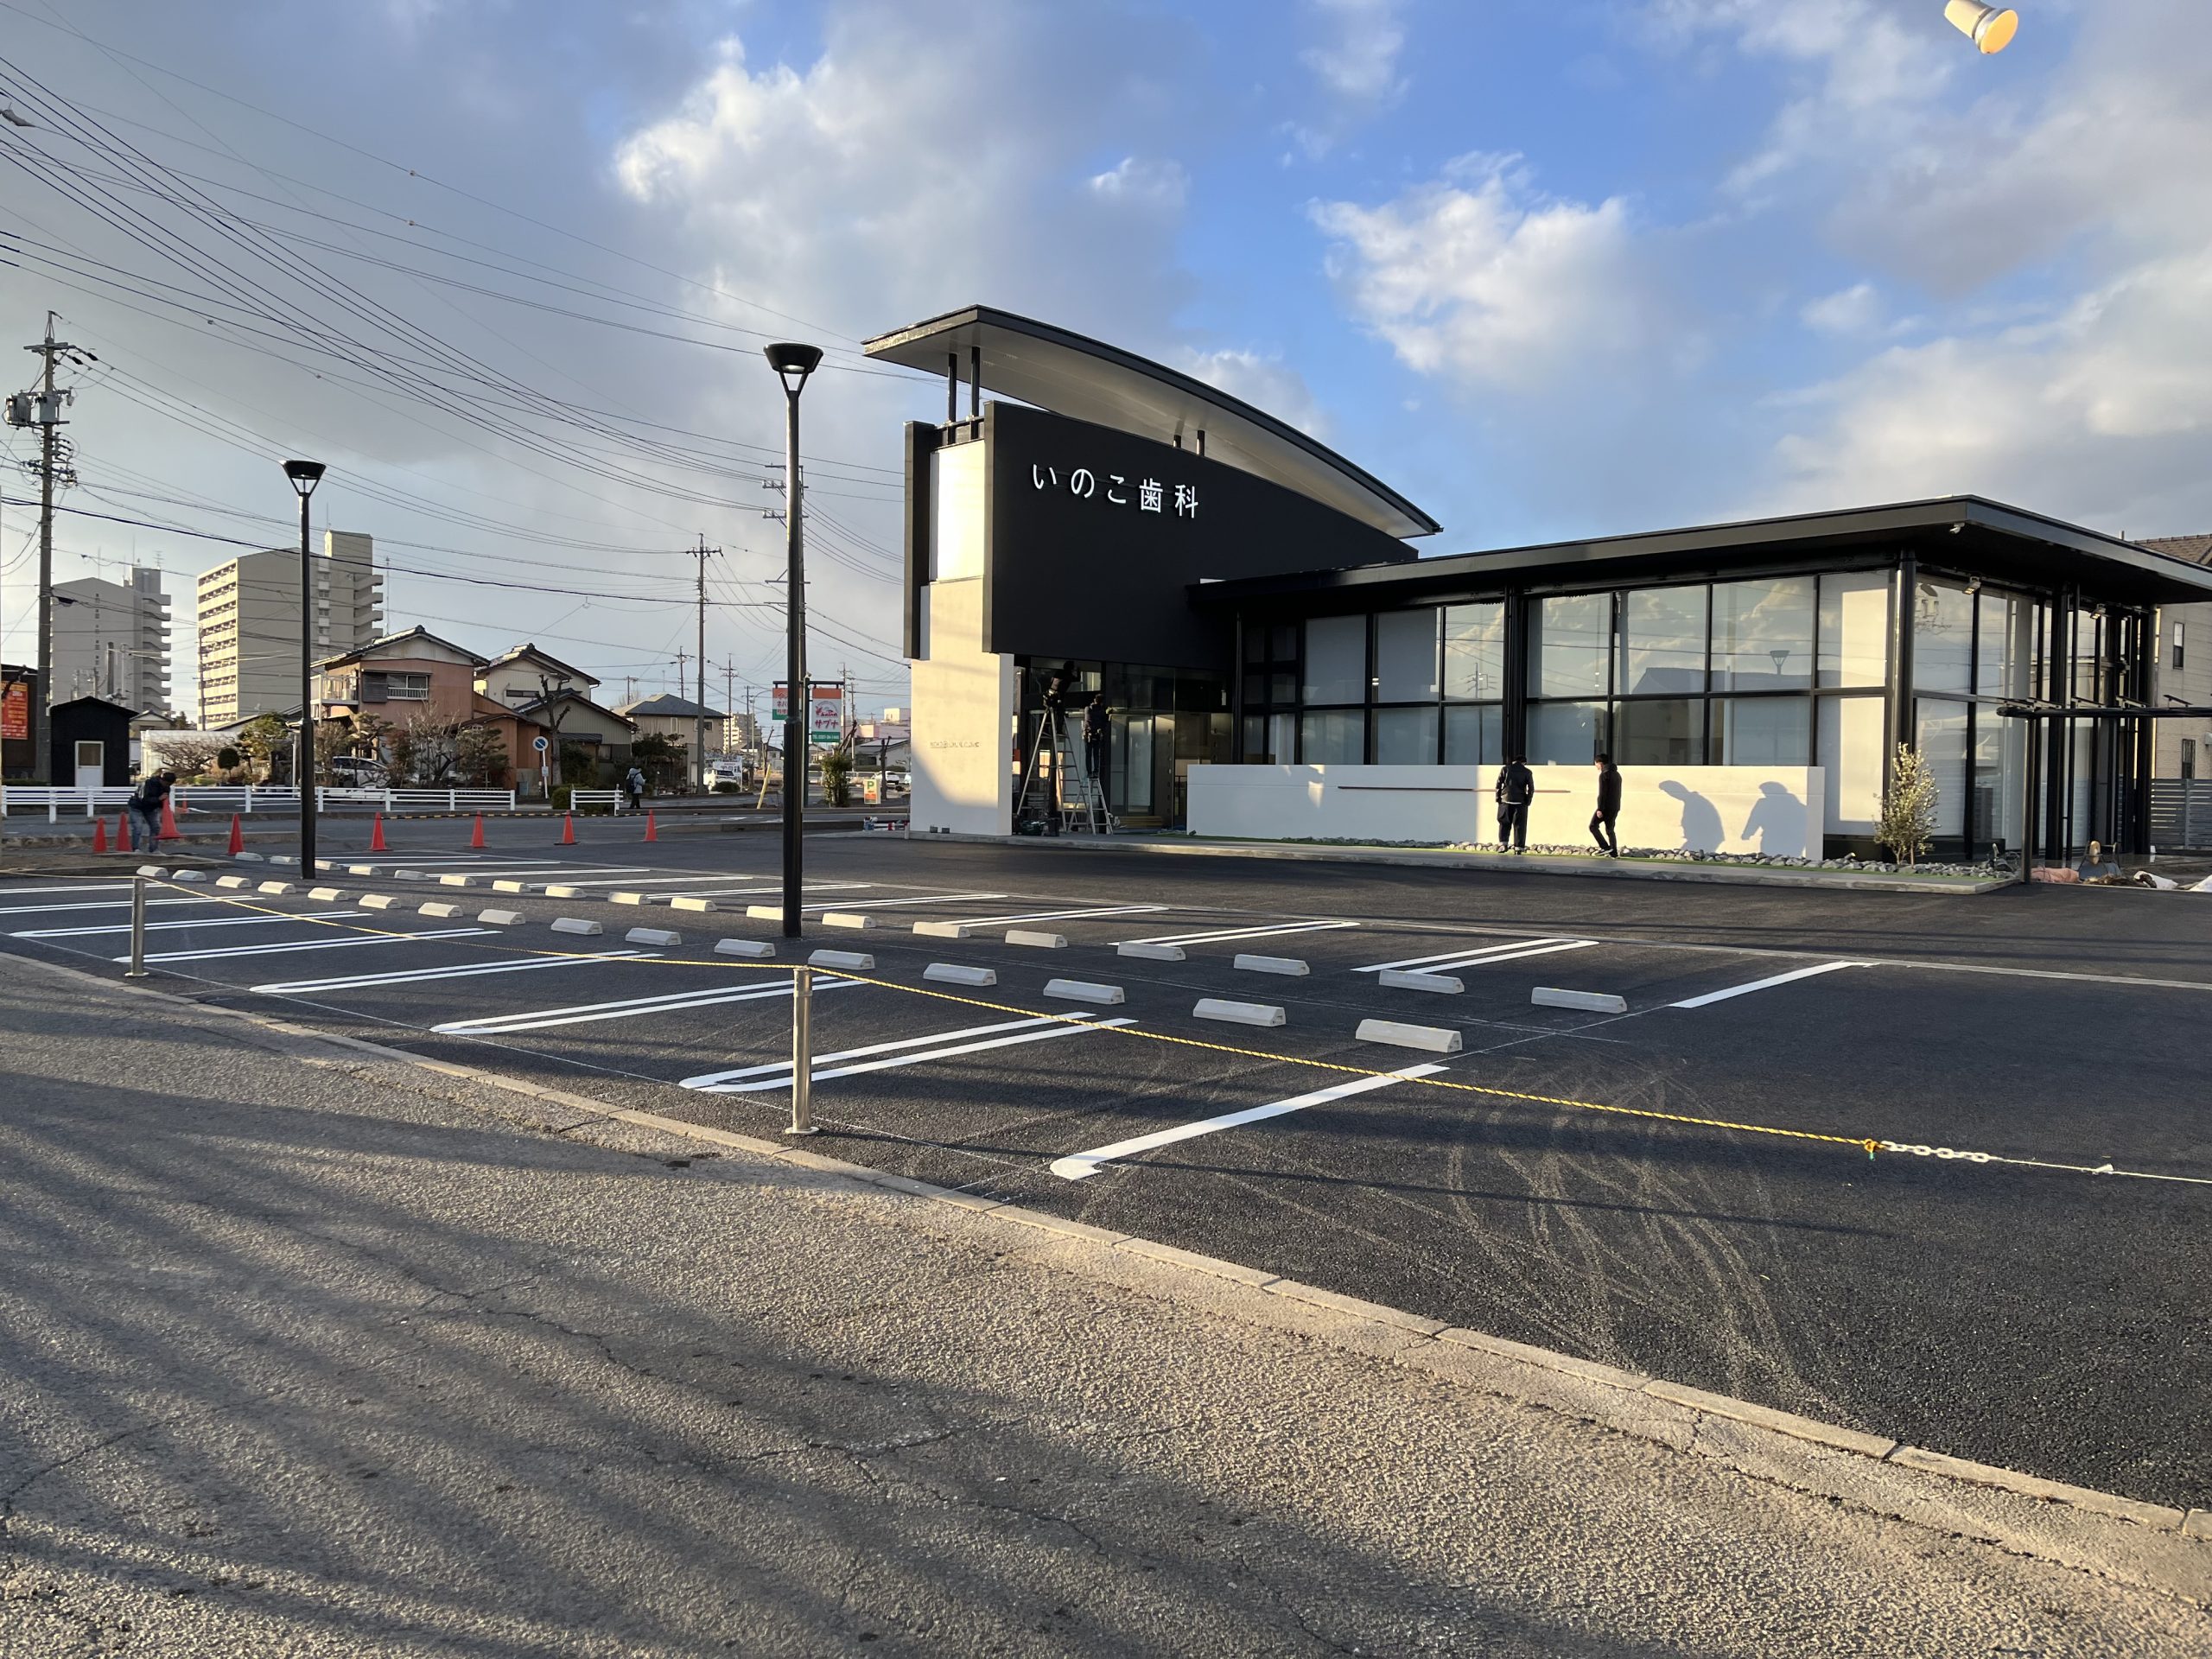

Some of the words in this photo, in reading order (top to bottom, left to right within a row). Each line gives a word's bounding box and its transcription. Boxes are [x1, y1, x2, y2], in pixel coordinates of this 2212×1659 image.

[1033, 463, 1198, 518] いのこ歯科
[867, 780, 874, 790] P
